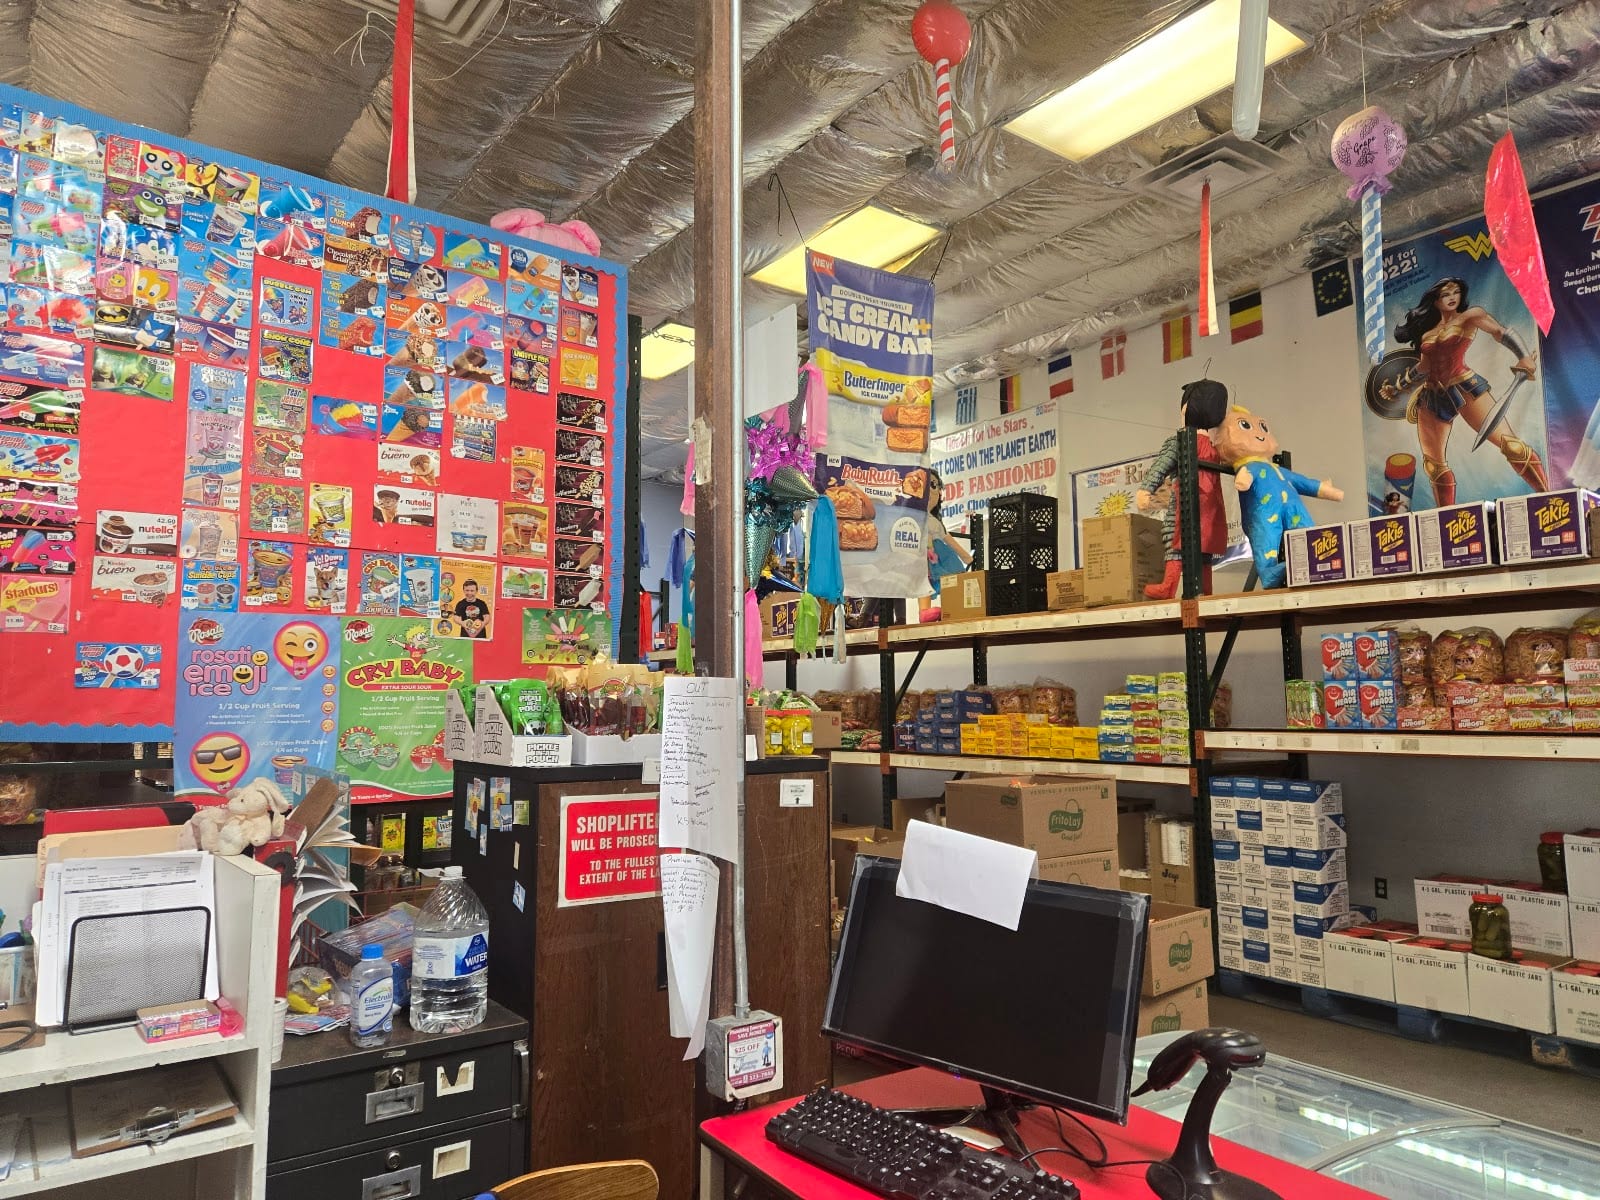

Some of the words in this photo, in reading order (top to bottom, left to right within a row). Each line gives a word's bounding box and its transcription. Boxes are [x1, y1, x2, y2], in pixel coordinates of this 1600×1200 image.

[330, 216, 355, 229] CRUNCH
[1397, 248, 1416, 261] for
[264, 280, 294, 291] BUBBLE
[295, 286, 312, 295] GUM
[816, 291, 847, 321] ICE
[818, 313, 884, 349] CANDY
[887, 333, 933, 355] BAR
[202, 367, 238, 378] SNOW
[844, 371, 907, 395] Butterfinger
[861, 390, 870, 398] ICE
[870, 392, 889, 401] CREAM
[987, 425, 1001, 439] the
[1004, 418, 1028, 434] Stars
[381, 451, 410, 460] bueno
[945, 455, 964, 475] CONE
[967, 451, 977, 469] ON
[980, 447, 994, 465] THE
[997, 437, 1026, 462] PLANET
[1029, 429, 1056, 453] EARTH
[969, 458, 1056, 494] FASHIONED
[873, 489, 893, 497] CREAM
[1535, 502, 1570, 530] Takis
[138, 525, 174, 534] nutella
[1446, 514, 1476, 541] Takis
[895, 531, 919, 543] REAL
[1376, 525, 1404, 551] Takis
[1312, 534, 1338, 559] Takis
[97, 565, 135, 576] bueno
[363, 561, 378, 574] CRY
[379, 560, 399, 576] BABY
[6, 583, 58, 599] Starburst
[188, 625, 224, 643] Rosati
[345, 625, 375, 641] Rosati
[1340, 641, 1353, 650] AIR
[1374, 640, 1388, 649] AIR
[192, 646, 252, 664] rosati
[1332, 648, 1354, 660] HEADS
[1367, 647, 1389, 660] HEADS
[347, 659, 394, 687] CRY
[400, 659, 463, 684] BABY
[189, 683, 232, 697] ice
[687, 682, 709, 693] OUT
[1343, 689, 1356, 698] AIR
[1378, 689, 1393, 698] AIR
[416, 695, 440, 703] Serving
[1335, 697, 1357, 708] HEADS
[1370, 696, 1394, 707] HEADS
[218, 702, 233, 710] 1/2
[235, 703, 250, 711] Cup
[252, 702, 270, 710] Fruit
[272, 702, 300, 711] Serving
[527, 743, 559, 752] PICKLE
[526, 755, 559, 764] POUCH
[571, 839, 595, 852] WILL
[600, 837, 612, 849] BE
[590, 860, 601, 871] TO
[605, 859, 621, 870] THE
[579, 872, 614, 885] EXTENT
[617, 871, 627, 881] OF
[631, 869, 647, 880] THE
[1444, 888, 1467, 896] PLASTIC
[1521, 896, 1544, 905] PLASTIC
[1546, 899, 1561, 907] JARS
[1351, 947, 1372, 956] PLASTIC
[465, 952, 487, 967] WATER
[1419, 959, 1442, 968] PLASTIC
[1443, 962, 1457, 970] JARS
[1502, 968, 1526, 979] PLASTIC
[1528, 972, 1543, 982] JARS
[747, 1043, 760, 1051] OFF
